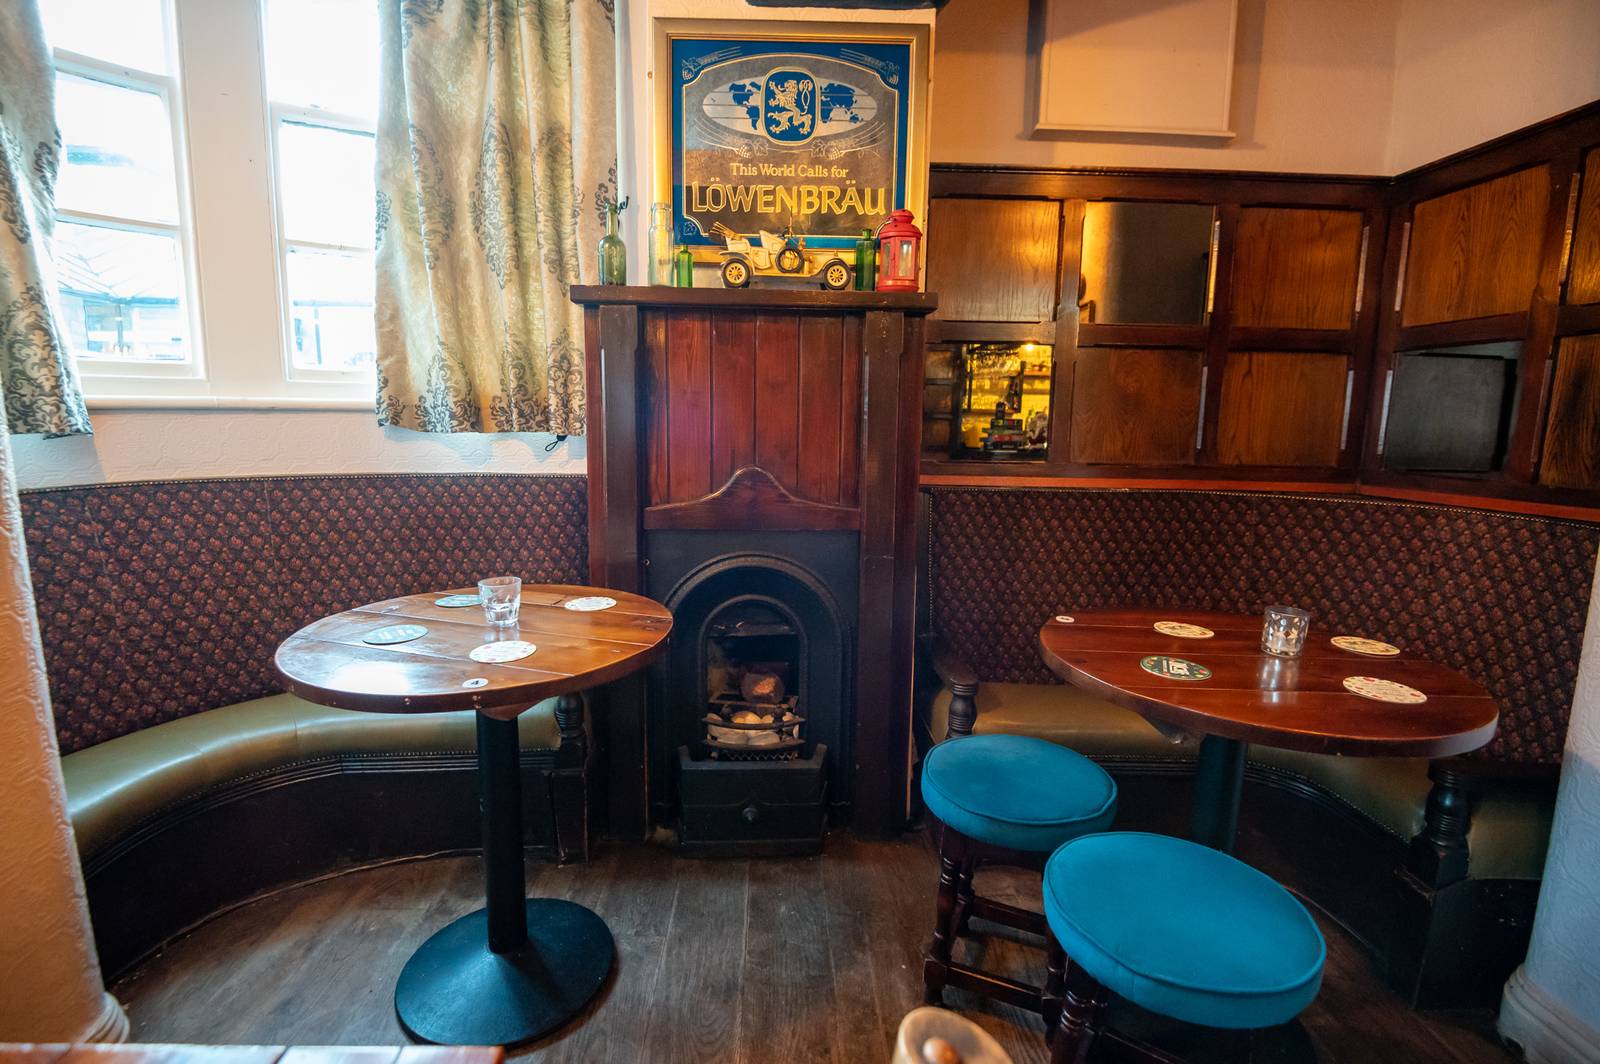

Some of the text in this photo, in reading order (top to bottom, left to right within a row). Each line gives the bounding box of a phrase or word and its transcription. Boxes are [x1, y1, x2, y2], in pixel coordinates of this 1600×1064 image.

[730, 163, 849, 178] This World Calls for
[691, 177, 887, 216] LÖWENBRÄU
